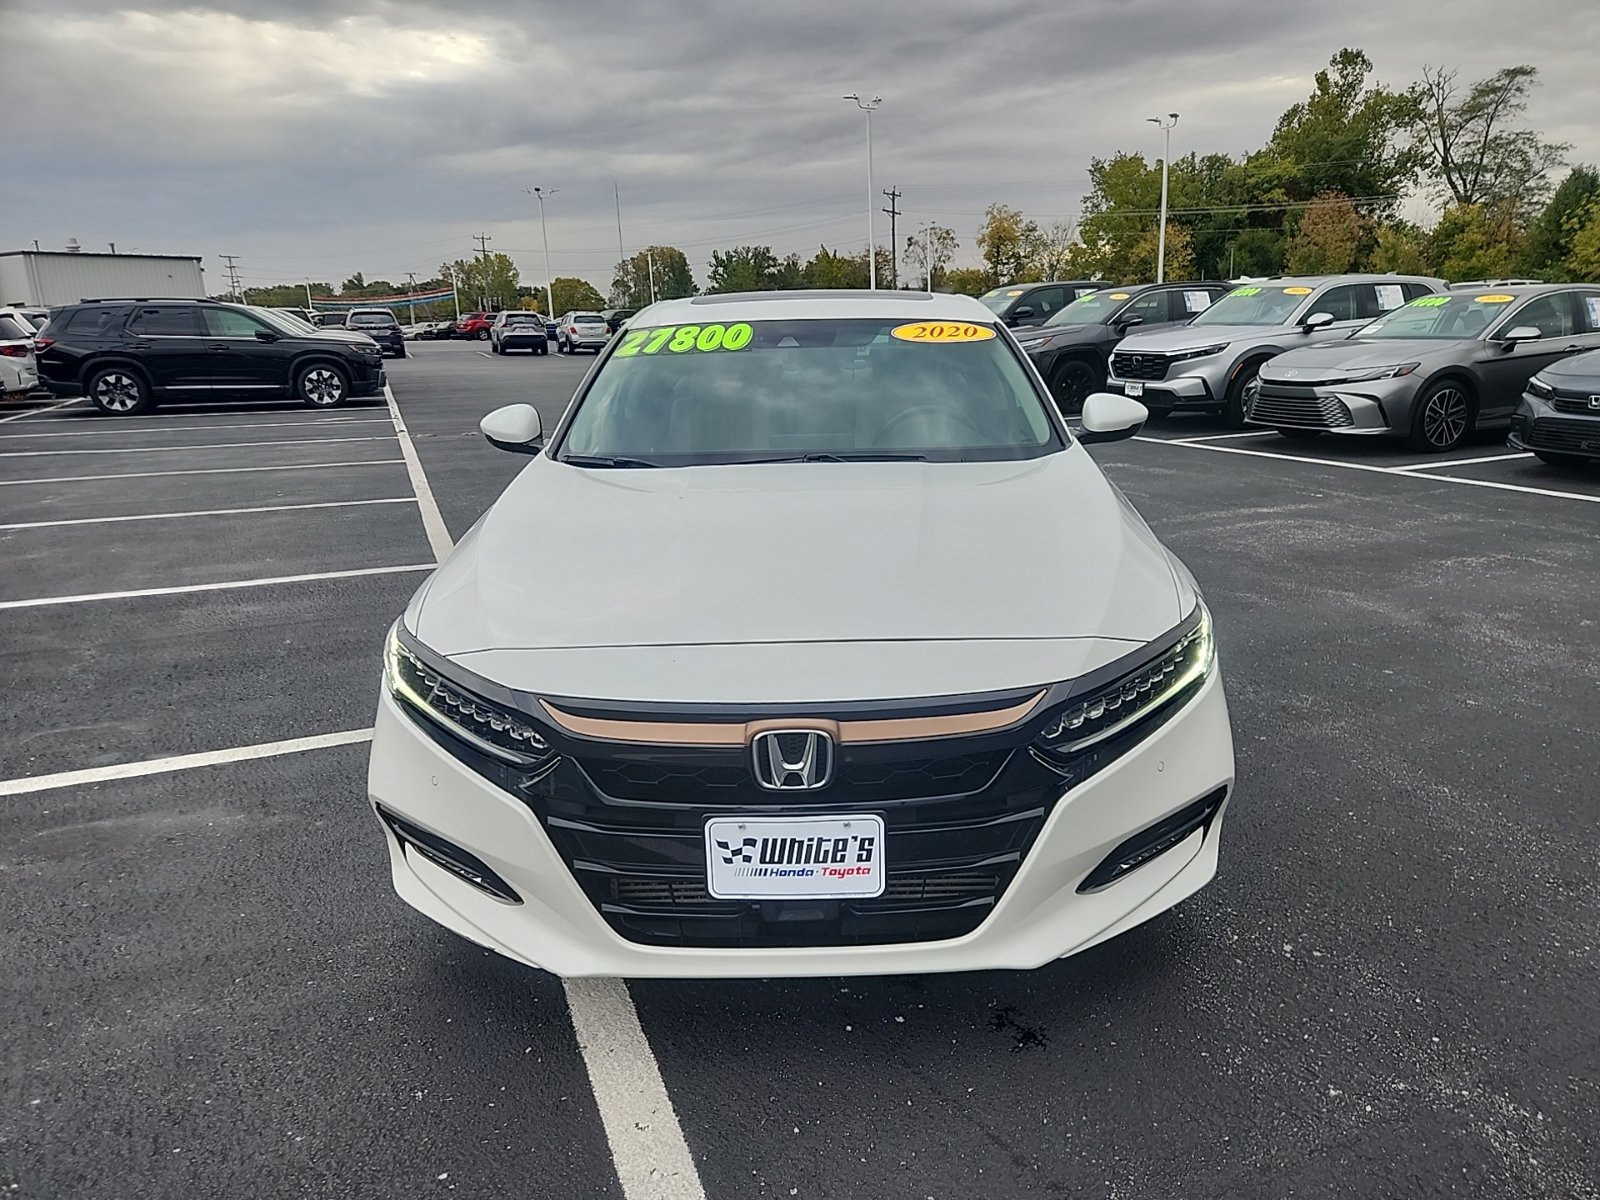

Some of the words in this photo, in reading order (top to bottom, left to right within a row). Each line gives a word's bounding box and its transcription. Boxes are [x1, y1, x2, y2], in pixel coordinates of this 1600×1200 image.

[613, 323, 754, 357] 27800
[911, 325, 979, 339] 2020
[758, 835, 875, 865] White's
[769, 867, 814, 878] Honda
[821, 865, 872, 879] Toyota
